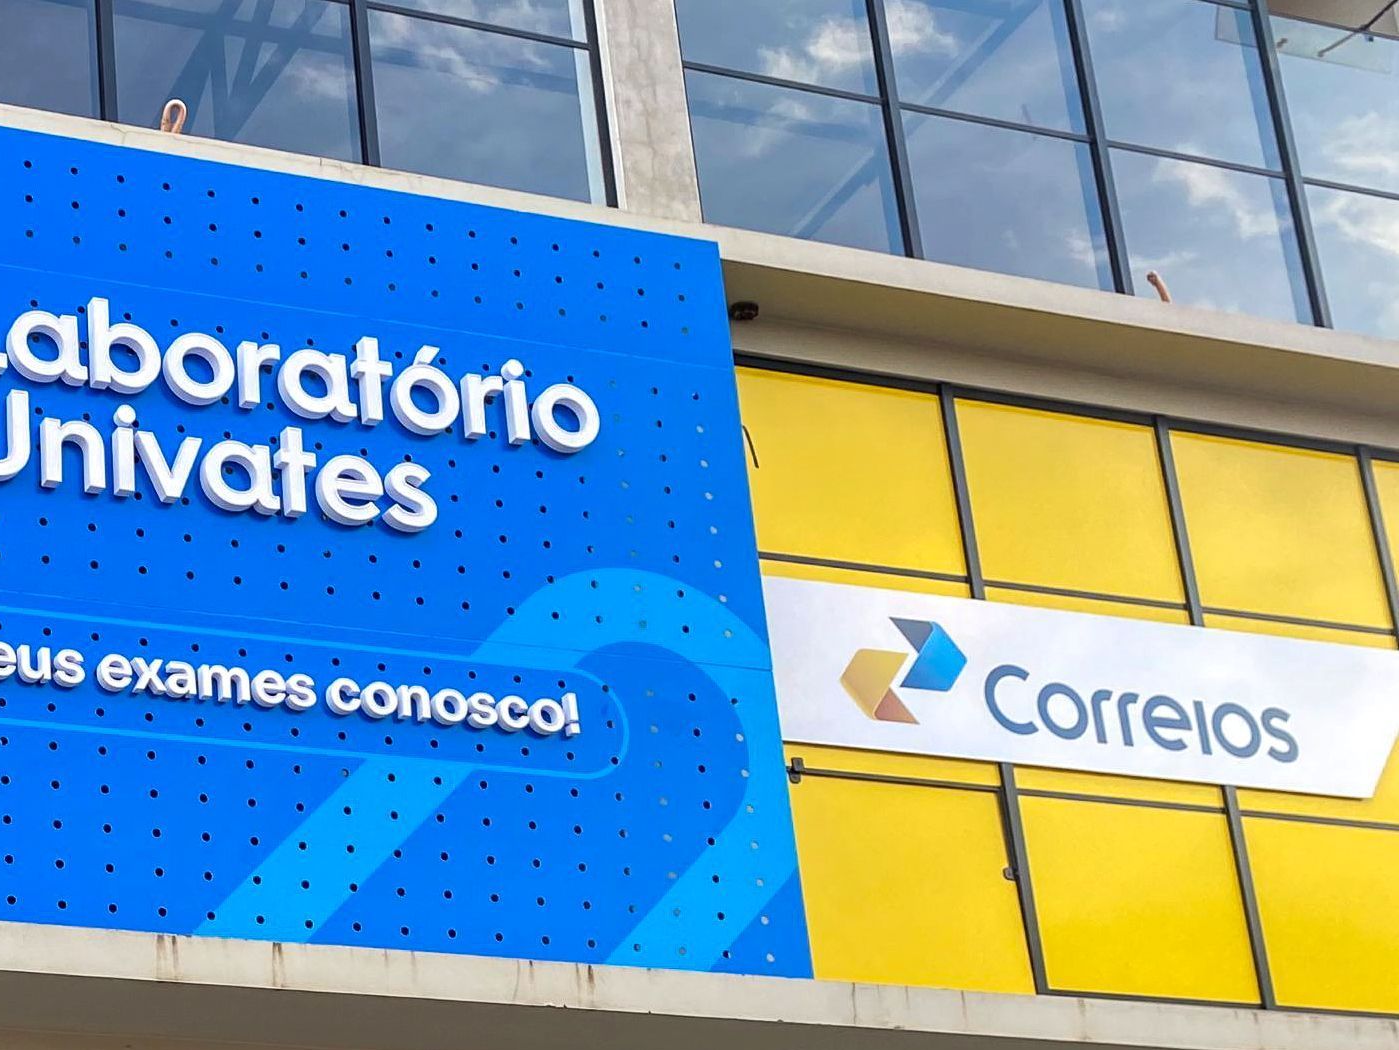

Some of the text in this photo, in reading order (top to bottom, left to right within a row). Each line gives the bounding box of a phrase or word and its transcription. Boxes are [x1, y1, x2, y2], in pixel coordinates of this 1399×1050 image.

[96, 652, 316, 712] exames
[326, 677, 581, 738] conosco!
[984, 664, 1299, 763] Correios
